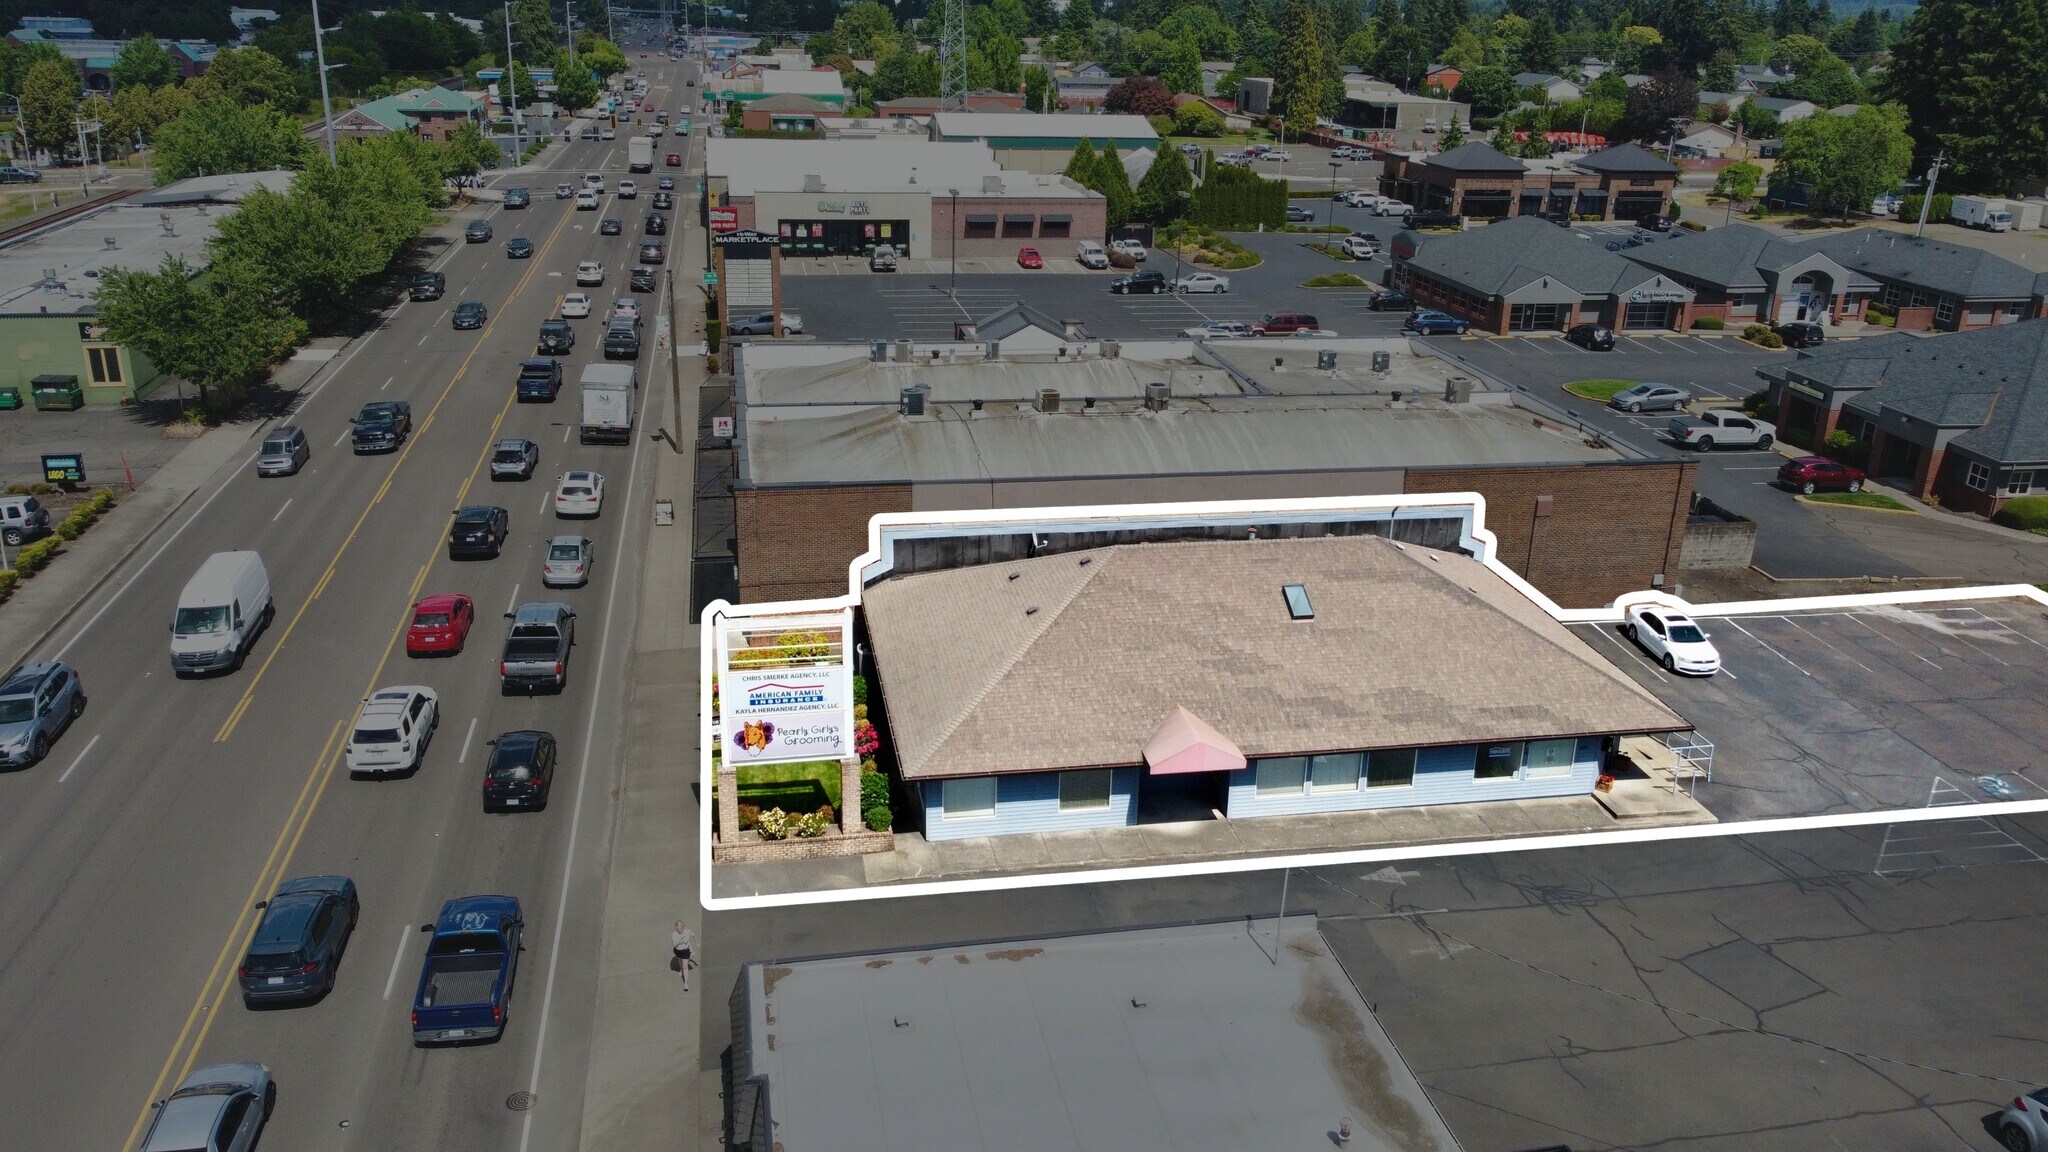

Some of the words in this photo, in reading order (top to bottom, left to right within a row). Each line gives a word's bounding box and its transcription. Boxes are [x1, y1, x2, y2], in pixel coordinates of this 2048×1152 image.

[750, 691, 792, 699] AMERICAN
[795, 689, 824, 697] FAMILY
[754, 696, 819, 705] INSURANCE
[735, 707, 757, 715] KAYLA
[758, 705, 798, 713] HERNANDEZ
[777, 726, 809, 737] Pearly
[811, 724, 839, 735] Girly's
[784, 735, 843, 748] Grooming
